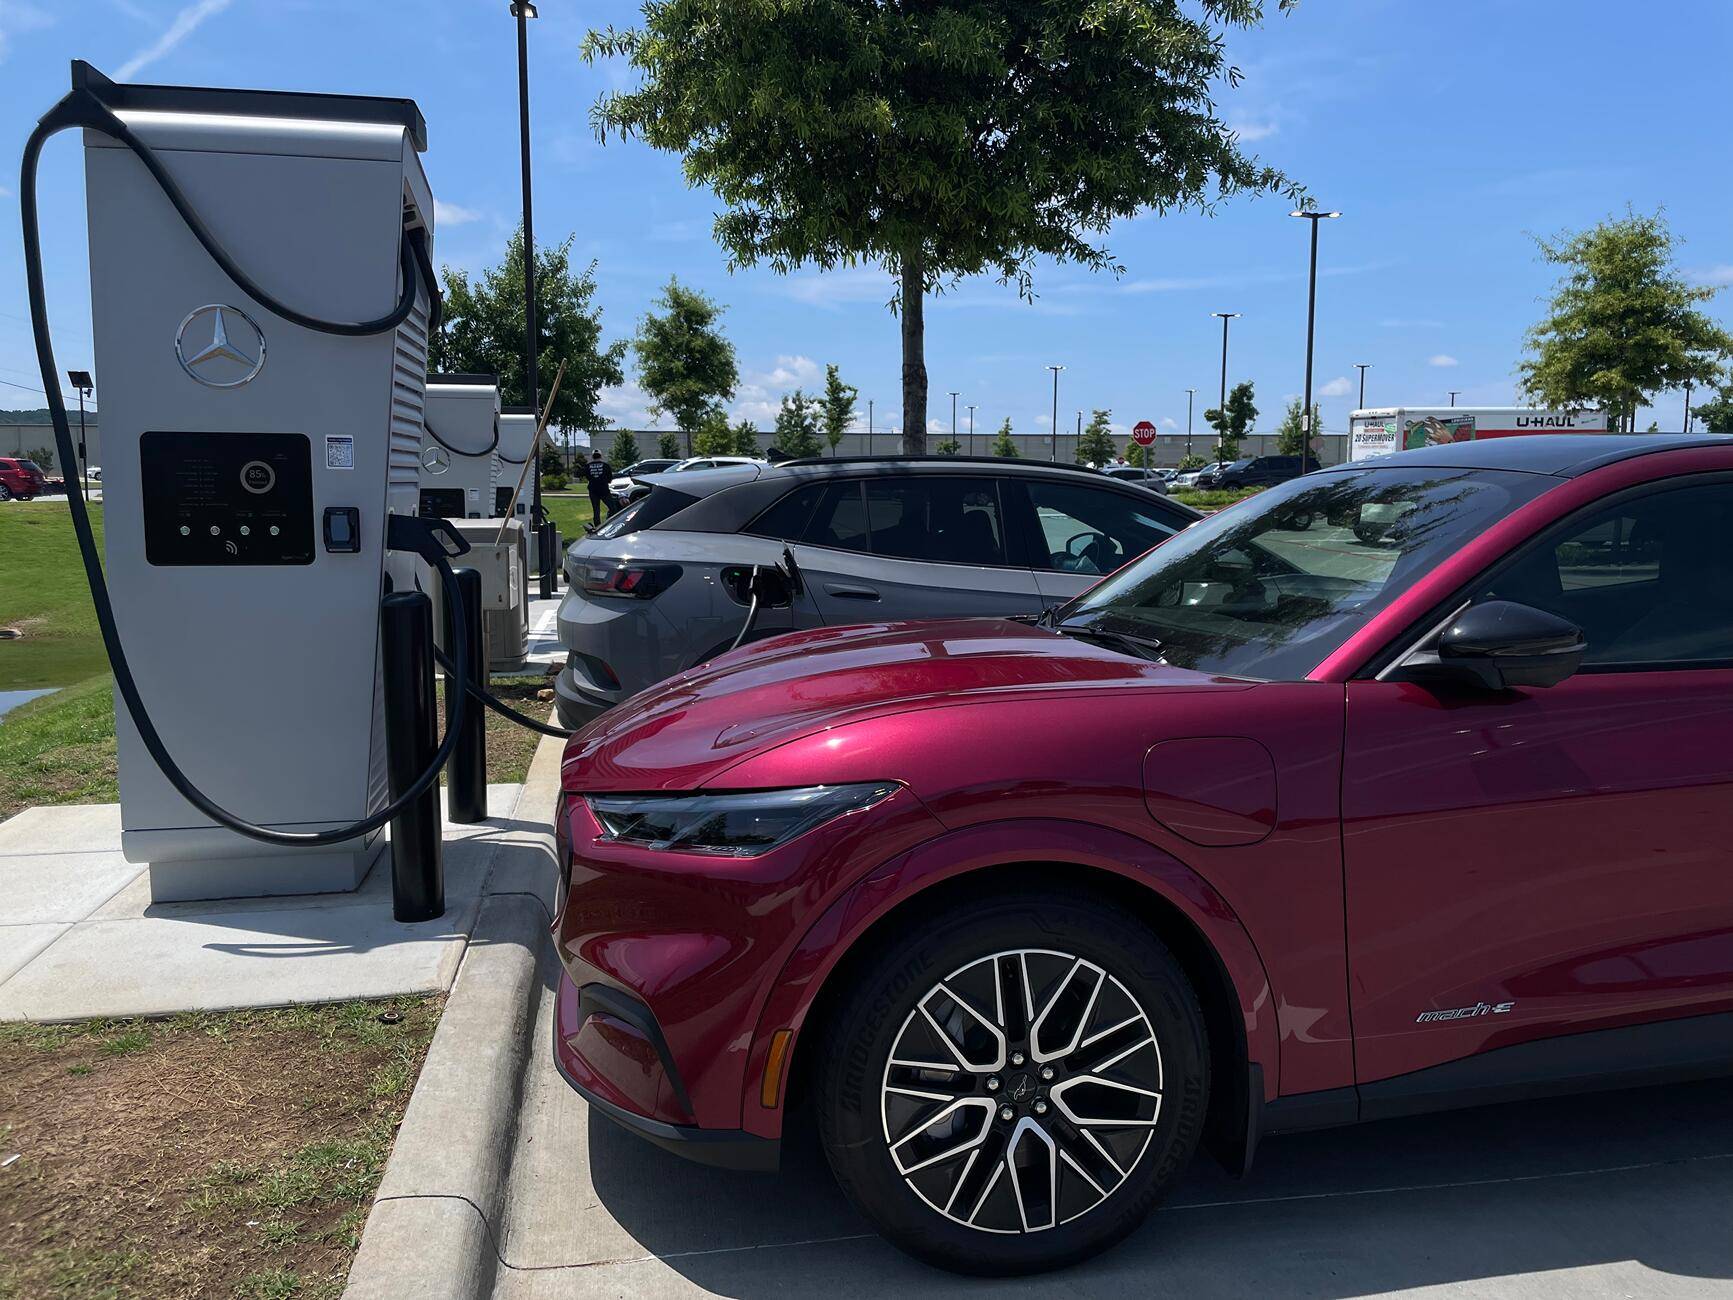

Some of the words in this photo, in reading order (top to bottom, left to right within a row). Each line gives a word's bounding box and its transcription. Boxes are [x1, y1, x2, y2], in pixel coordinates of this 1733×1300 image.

[1516, 417, 1575, 427] U-HAUL
[1134, 428, 1155, 439] STOP
[1362, 433, 1395, 442] SUPERMOVER
